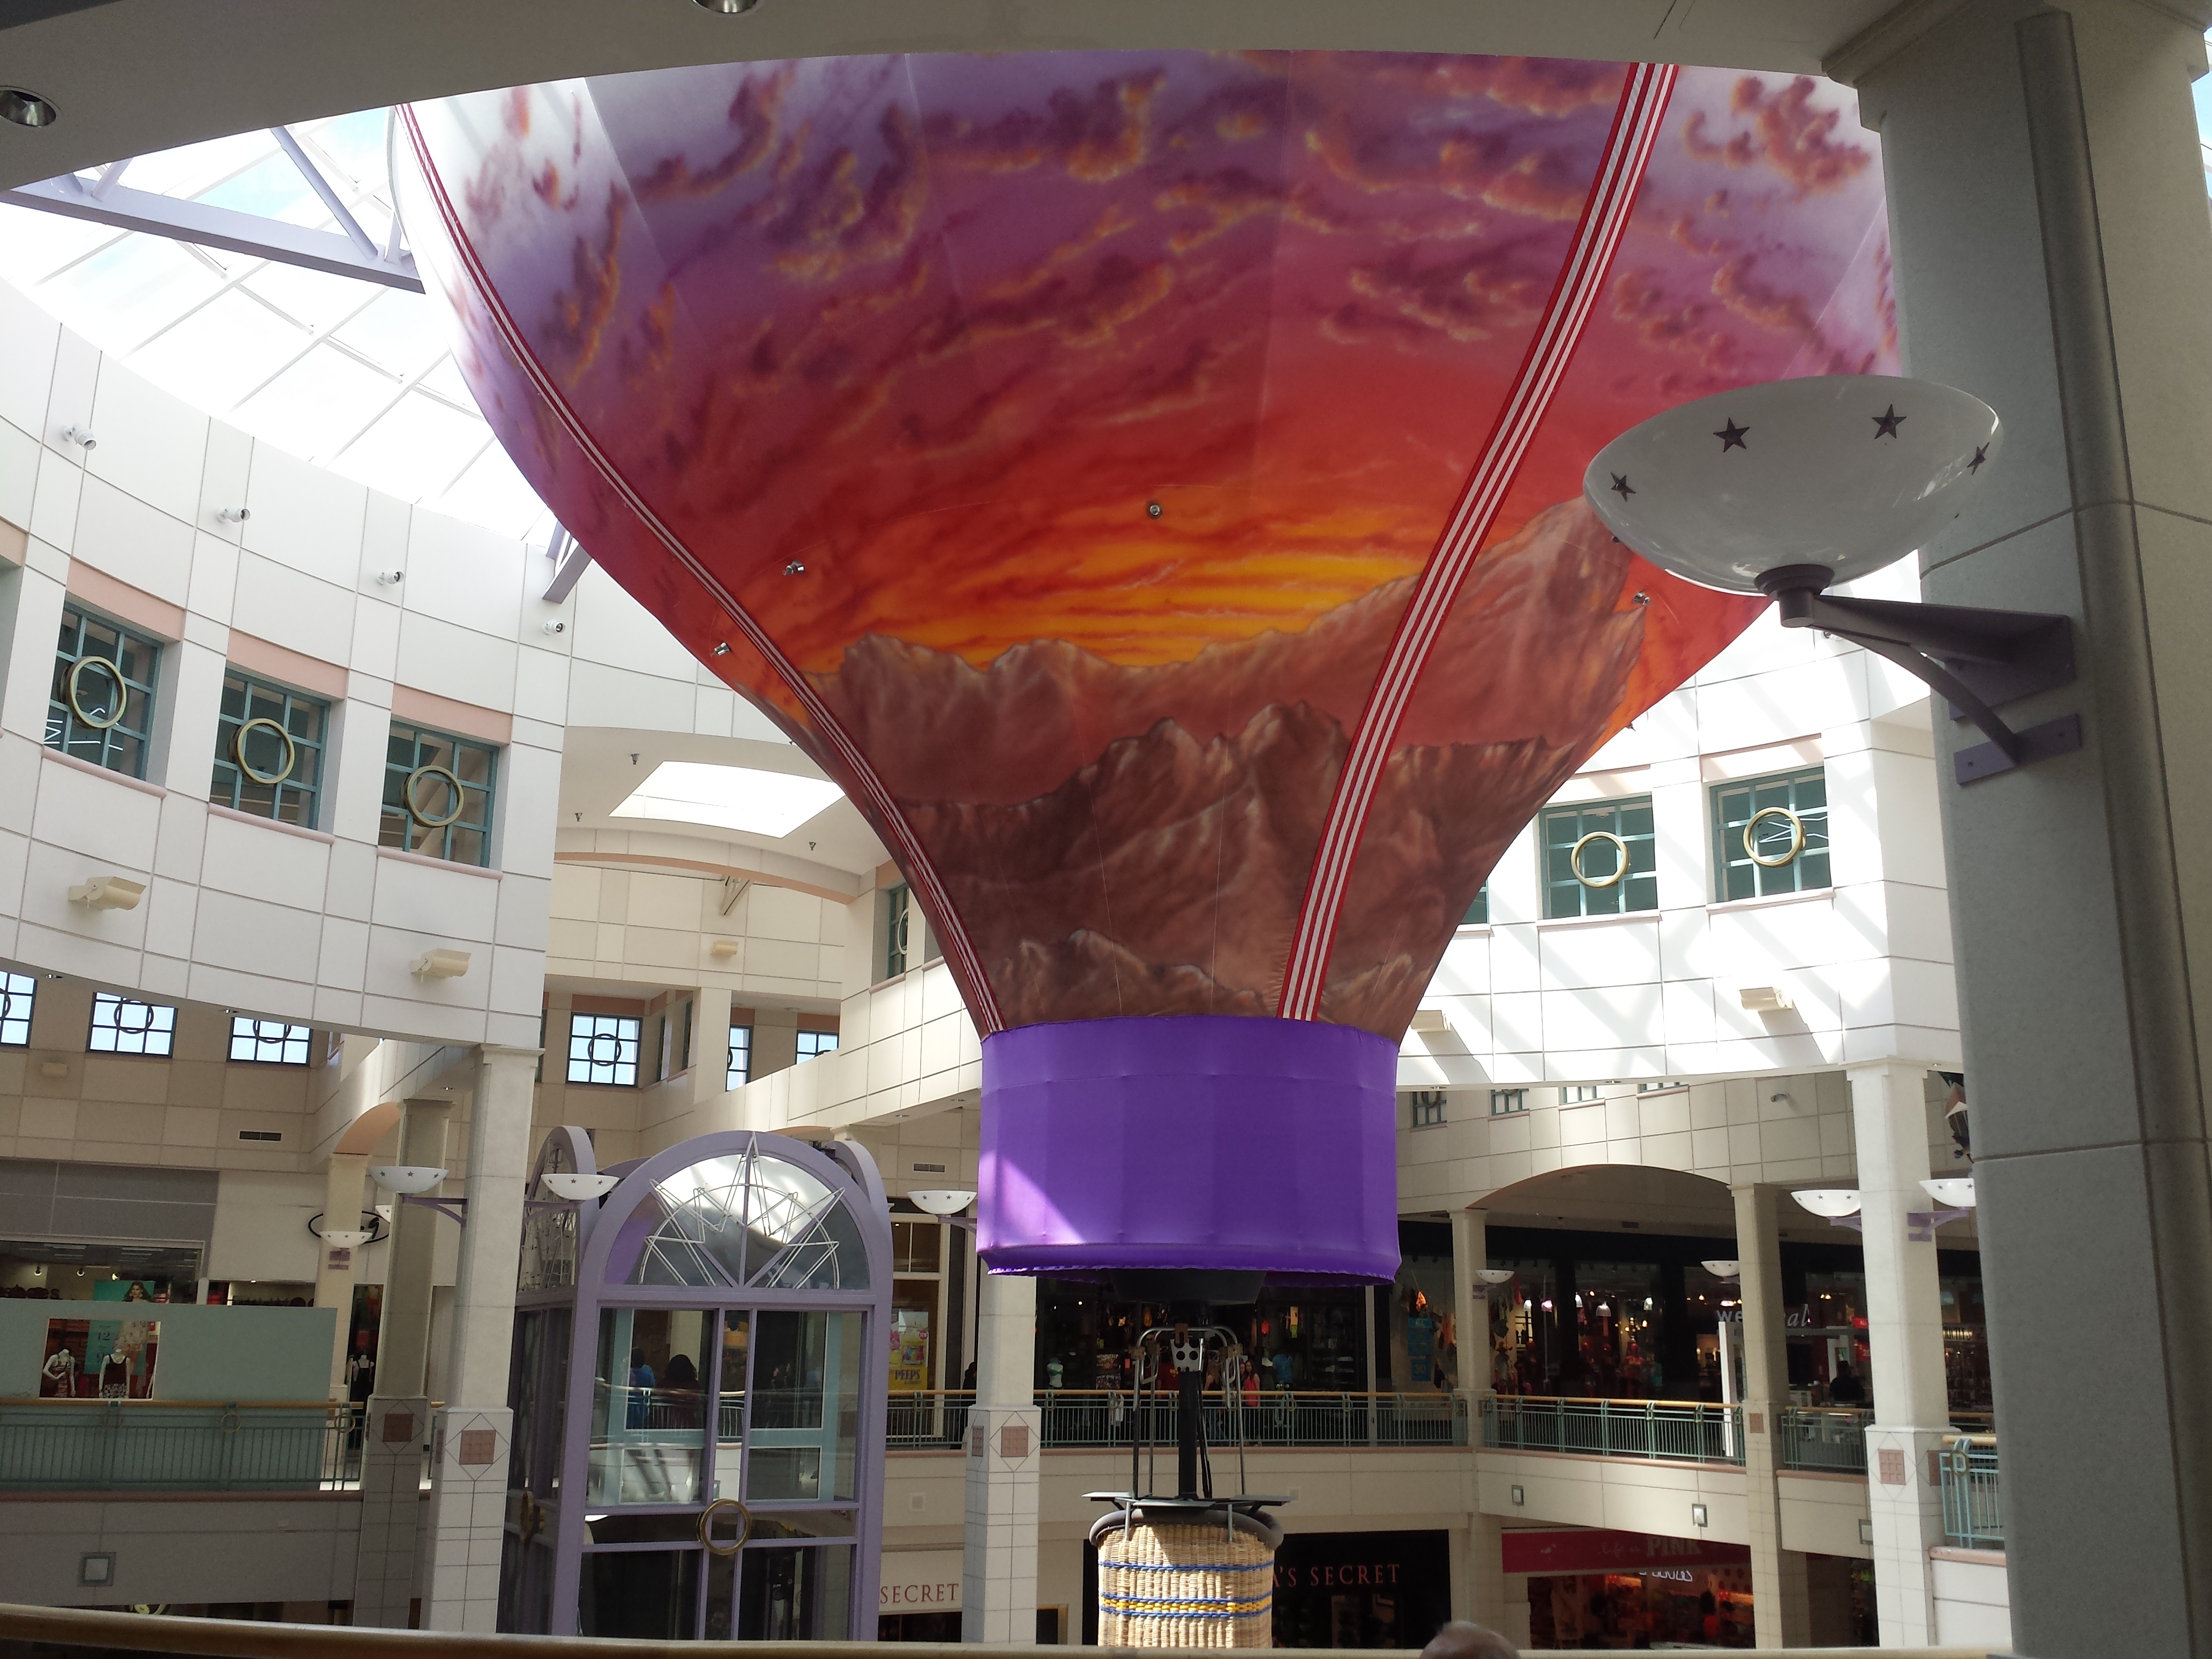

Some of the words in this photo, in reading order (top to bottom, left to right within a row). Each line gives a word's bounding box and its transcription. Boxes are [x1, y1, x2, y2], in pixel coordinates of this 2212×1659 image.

[1784, 1304, 1809, 1327] al
[894, 1369, 920, 1380] PEEPS
[1647, 1535, 1702, 1557] PINK
[1310, 1564, 1400, 1587] SECRET
[880, 1583, 959, 1604] SECRET
